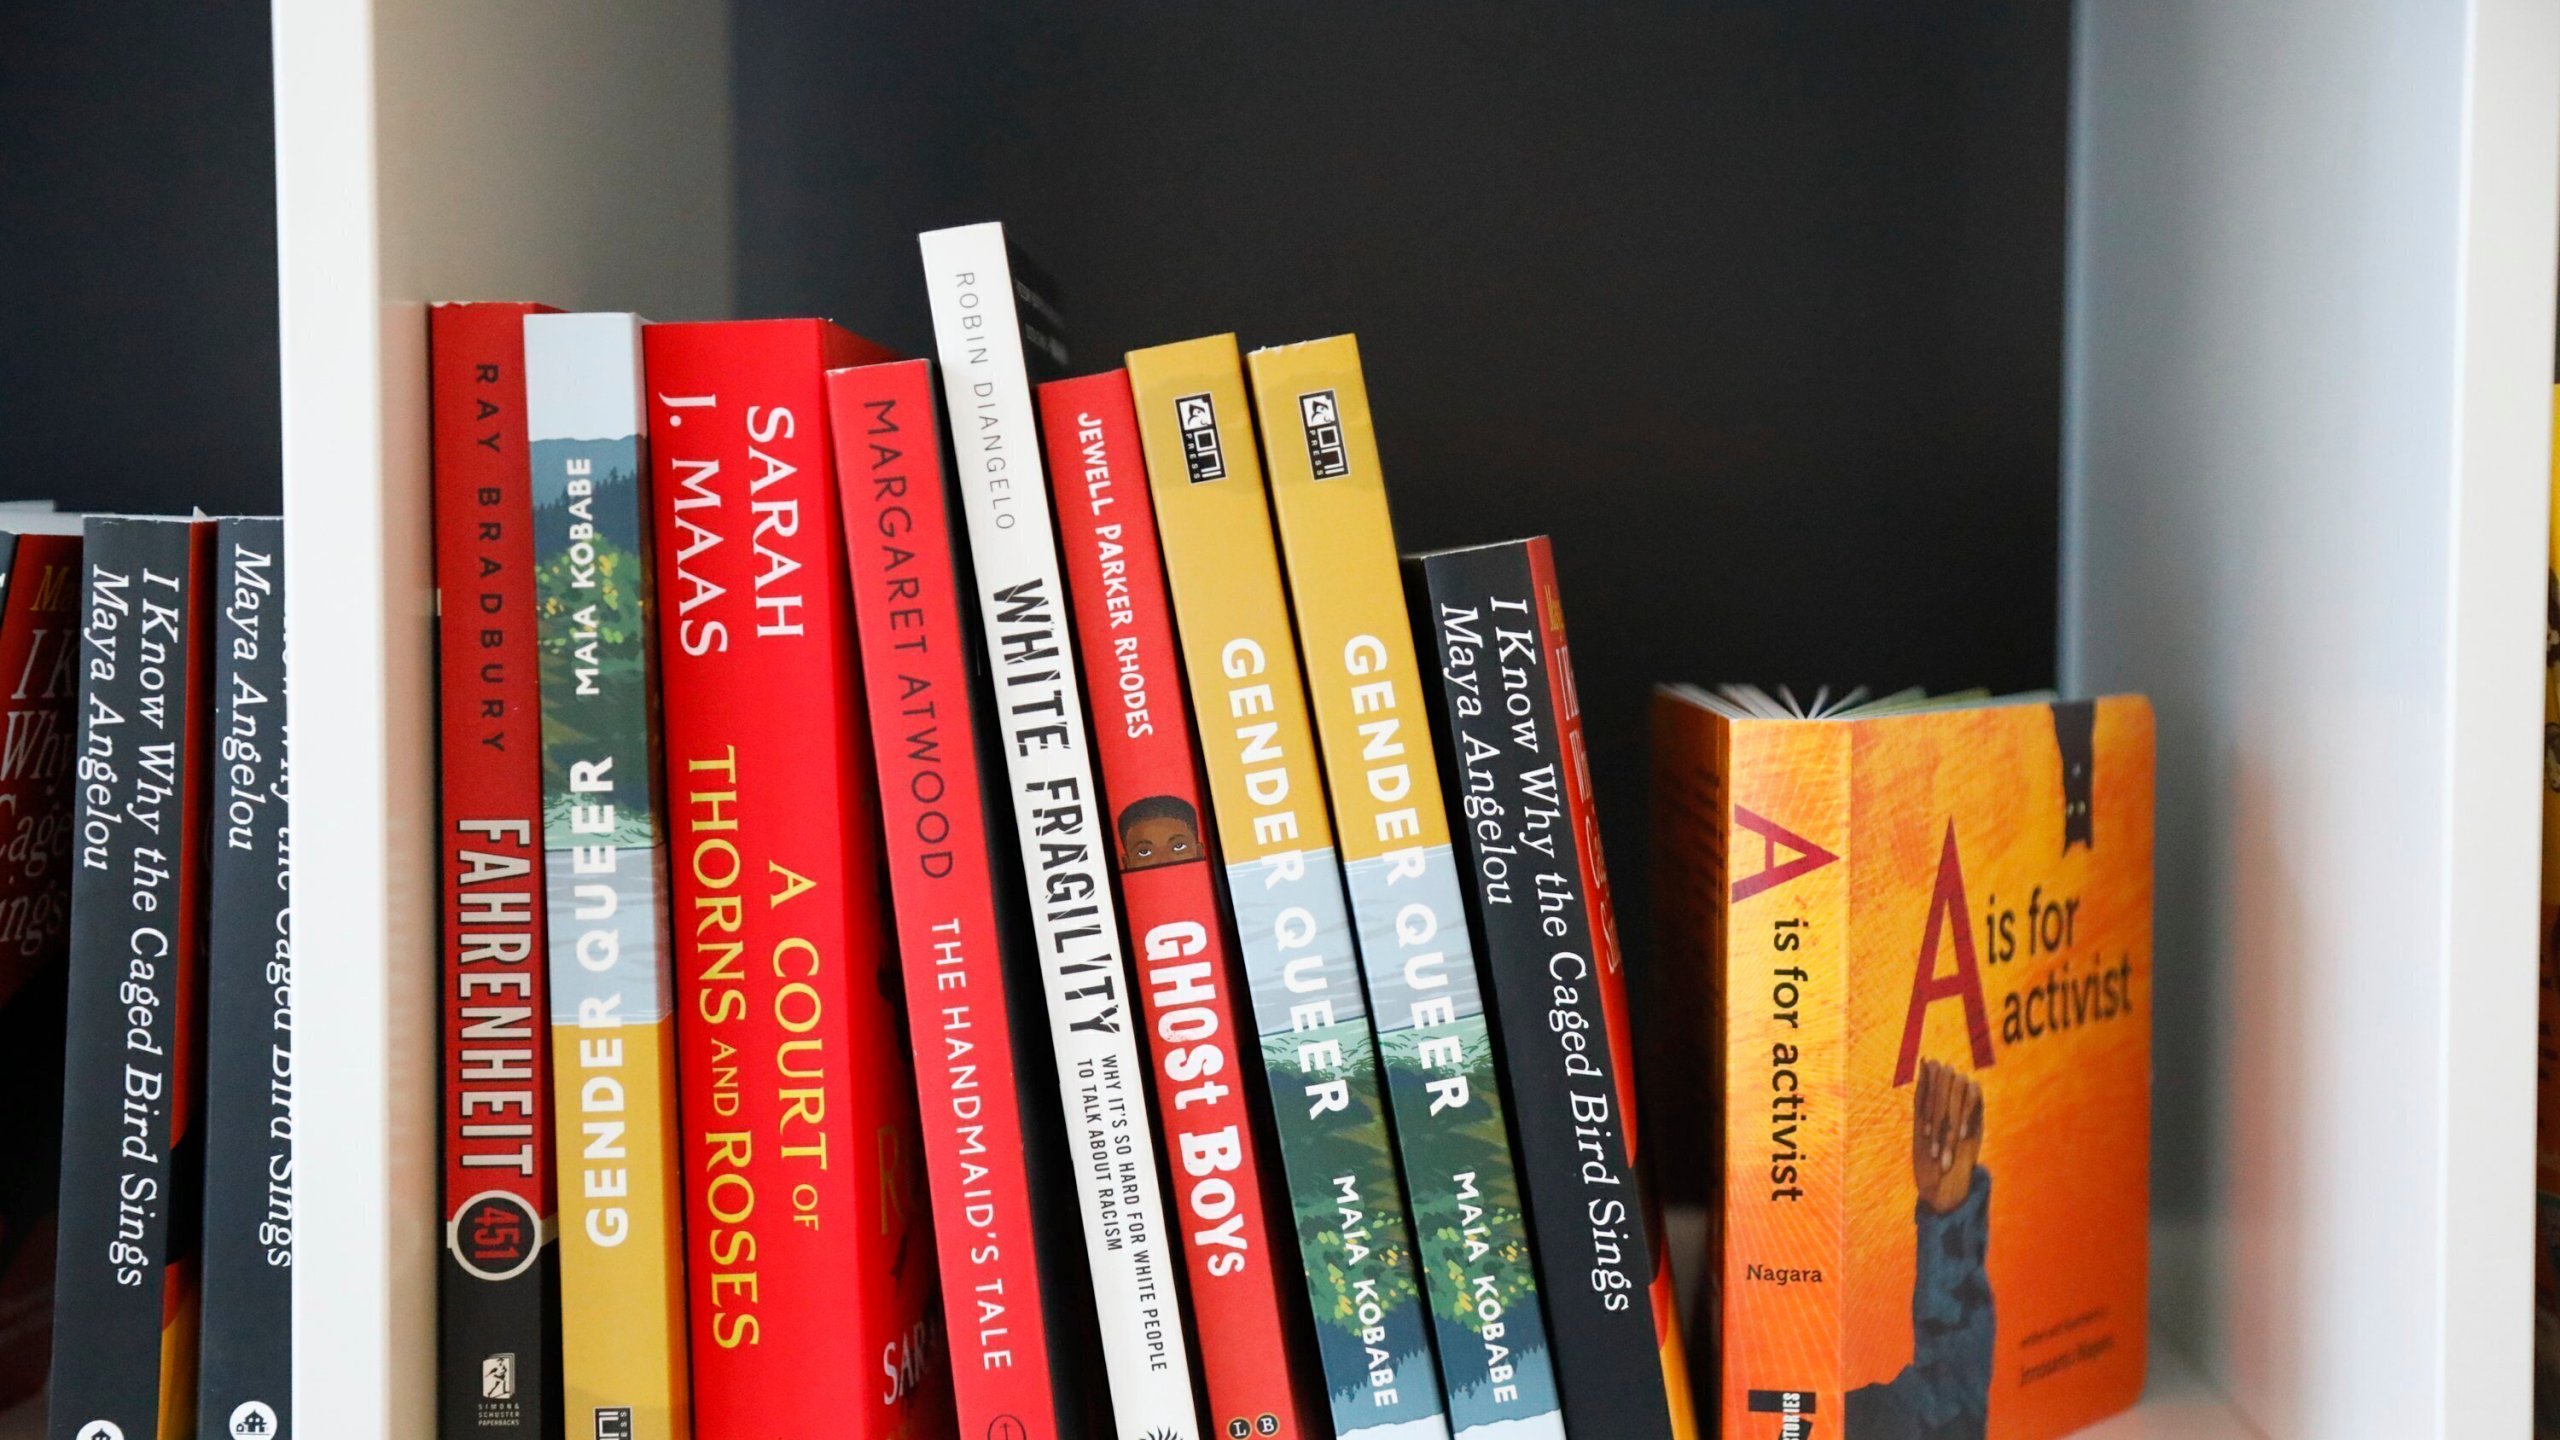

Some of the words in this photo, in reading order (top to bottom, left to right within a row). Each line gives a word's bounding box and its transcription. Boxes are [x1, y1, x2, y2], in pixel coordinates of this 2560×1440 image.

[475, 363, 499, 453] RAY
[658, 392, 717, 427] J.
[956, 271, 988, 365] ROBIN
[973, 381, 1015, 531] DIANGELO
[1185, 433, 1200, 479] PRESS
[1309, 430, 1324, 476] PRESS
[567, 458, 596, 589] KOBABE
[672, 458, 728, 657] MAAS
[746, 405, 804, 638] SARAH
[83, 564, 130, 681] Maya
[142, 568, 179, 592] I
[226, 543, 271, 661] Maya
[478, 487, 505, 752] BRADBURY
[1076, 411, 1114, 516] JEWELL
[1095, 525, 1133, 630] PARKER
[1114, 635, 1153, 740] RHODES
[1490, 596, 1528, 614] I
[139, 599, 178, 729] Know
[571, 605, 600, 695] MAIA
[864, 399, 928, 654] MARGARET
[897, 672, 953, 879] ATWOOD
[992, 578, 1072, 757] WHITE
[1440, 602, 1483, 718] Maya
[1495, 626, 1539, 753] Know
[78, 697, 125, 871] Angelou
[127, 742, 175, 835] Why
[222, 675, 268, 851] Angelou
[1518, 763, 1560, 859] Why
[569, 756, 620, 973] QUEER
[1461, 731, 1517, 905] Angelou
[1731, 802, 1841, 904] A
[132, 849, 170, 911] the
[688, 744, 746, 1026] THORNS
[769, 859, 818, 909] A
[1025, 776, 1120, 1034] FRAGILITY
[1222, 638, 1304, 890] GENDER
[1273, 907, 1349, 1120] QUEER
[1344, 634, 1426, 887] GENDER
[1394, 903, 1470, 1118] QUEER
[1535, 870, 1574, 937] the
[931, 918, 966, 990] THE
[1774, 917, 1809, 952] is
[1892, 815, 1996, 1088] A
[1986, 896, 2016, 964] is
[2028, 884, 2081, 954] for
[120, 926, 168, 1055] Caged
[455, 818, 534, 1177] FAHRENHEIT
[1548, 951, 1603, 1078] Caged
[1773, 963, 1809, 1029] for
[2003, 953, 2133, 1047] activist
[710, 1038, 739, 1118] AND
[773, 936, 827, 1170] COURT
[1077, 1058, 1094, 1079] TO
[1081, 1084, 1101, 1124] TALK
[1101, 1054, 1121, 1090] WHY
[122, 1064, 162, 1163] Bird
[578, 993, 628, 1248] GENDER
[941, 1006, 999, 1265] HANDMAID'S
[1088, 1130, 1111, 1182] ABOUT
[1108, 1097, 1127, 1129] IT'S
[1114, 1134, 1132, 1155] SO
[1570, 1090, 1620, 1185] Bird
[1771, 1044, 1807, 1203] activist
[108, 1172, 158, 1287] Sings
[259, 1154, 291, 1267] Sings
[472, 1206, 520, 1260] 451
[792, 1184, 819, 1231] OF
[1097, 1189, 1123, 1252] RACISM
[1118, 1162, 1140, 1205] HARD
[1127, 1212, 1146, 1245] FOR
[1178, 1125, 1248, 1277] BOYS
[705, 1129, 760, 1349] ROSES
[1133, 1249, 1156, 1302] WHITE
[1453, 1170, 1489, 1263] MAIA
[1473, 1274, 1518, 1404] KOBABE
[1587, 1198, 1632, 1312] Sings
[1746, 1263, 1823, 1286] Nagara
[975, 1278, 1012, 1370] TALE
[1142, 1308, 1167, 1371] PEOPLE
[1332, 1174, 1370, 1267] MAIA
[1352, 1278, 1398, 1407] KOBABE
[1234, 1421, 1247, 1436] L
[1261, 1416, 1275, 1433] B
[1782, 1392, 1801, 1440] TORIES
